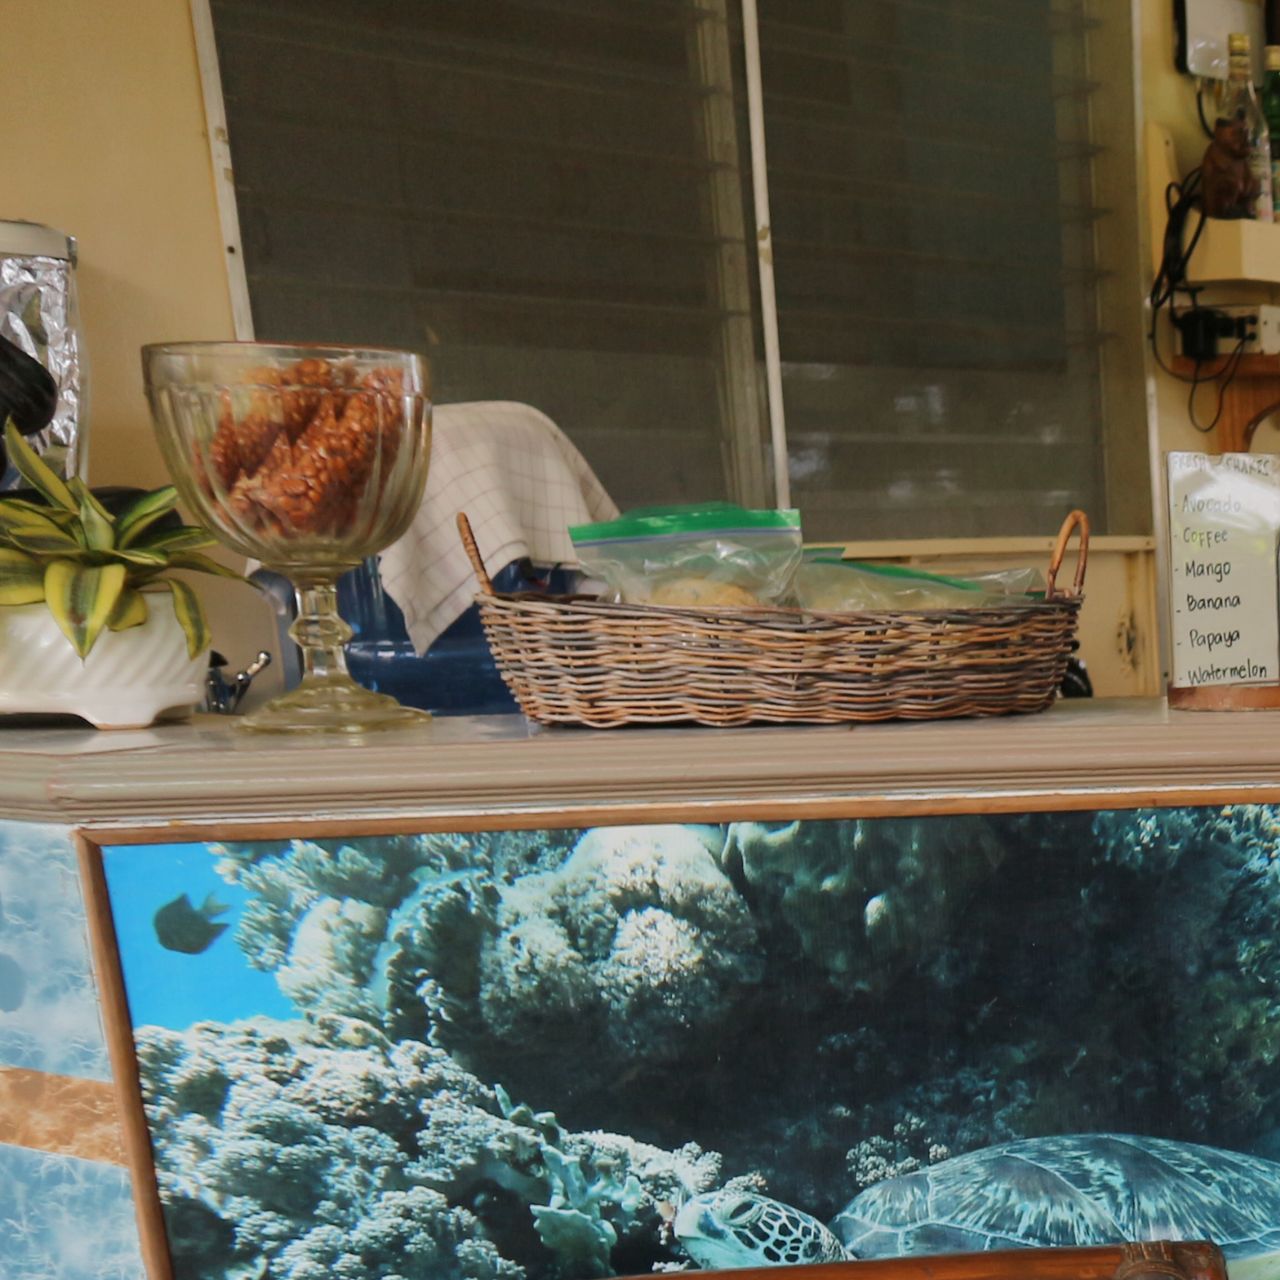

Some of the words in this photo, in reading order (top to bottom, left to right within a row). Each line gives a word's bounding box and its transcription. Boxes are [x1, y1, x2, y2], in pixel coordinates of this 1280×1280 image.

[1182, 494, 1242, 513] Avocado
[1183, 527, 1229, 549] Coffee
[1185, 560, 1232, 583] Mango
[1186, 593, 1241, 612] Banana
[1189, 628, 1240, 652] Papaya
[1187, 658, 1268, 685] Watermelon
